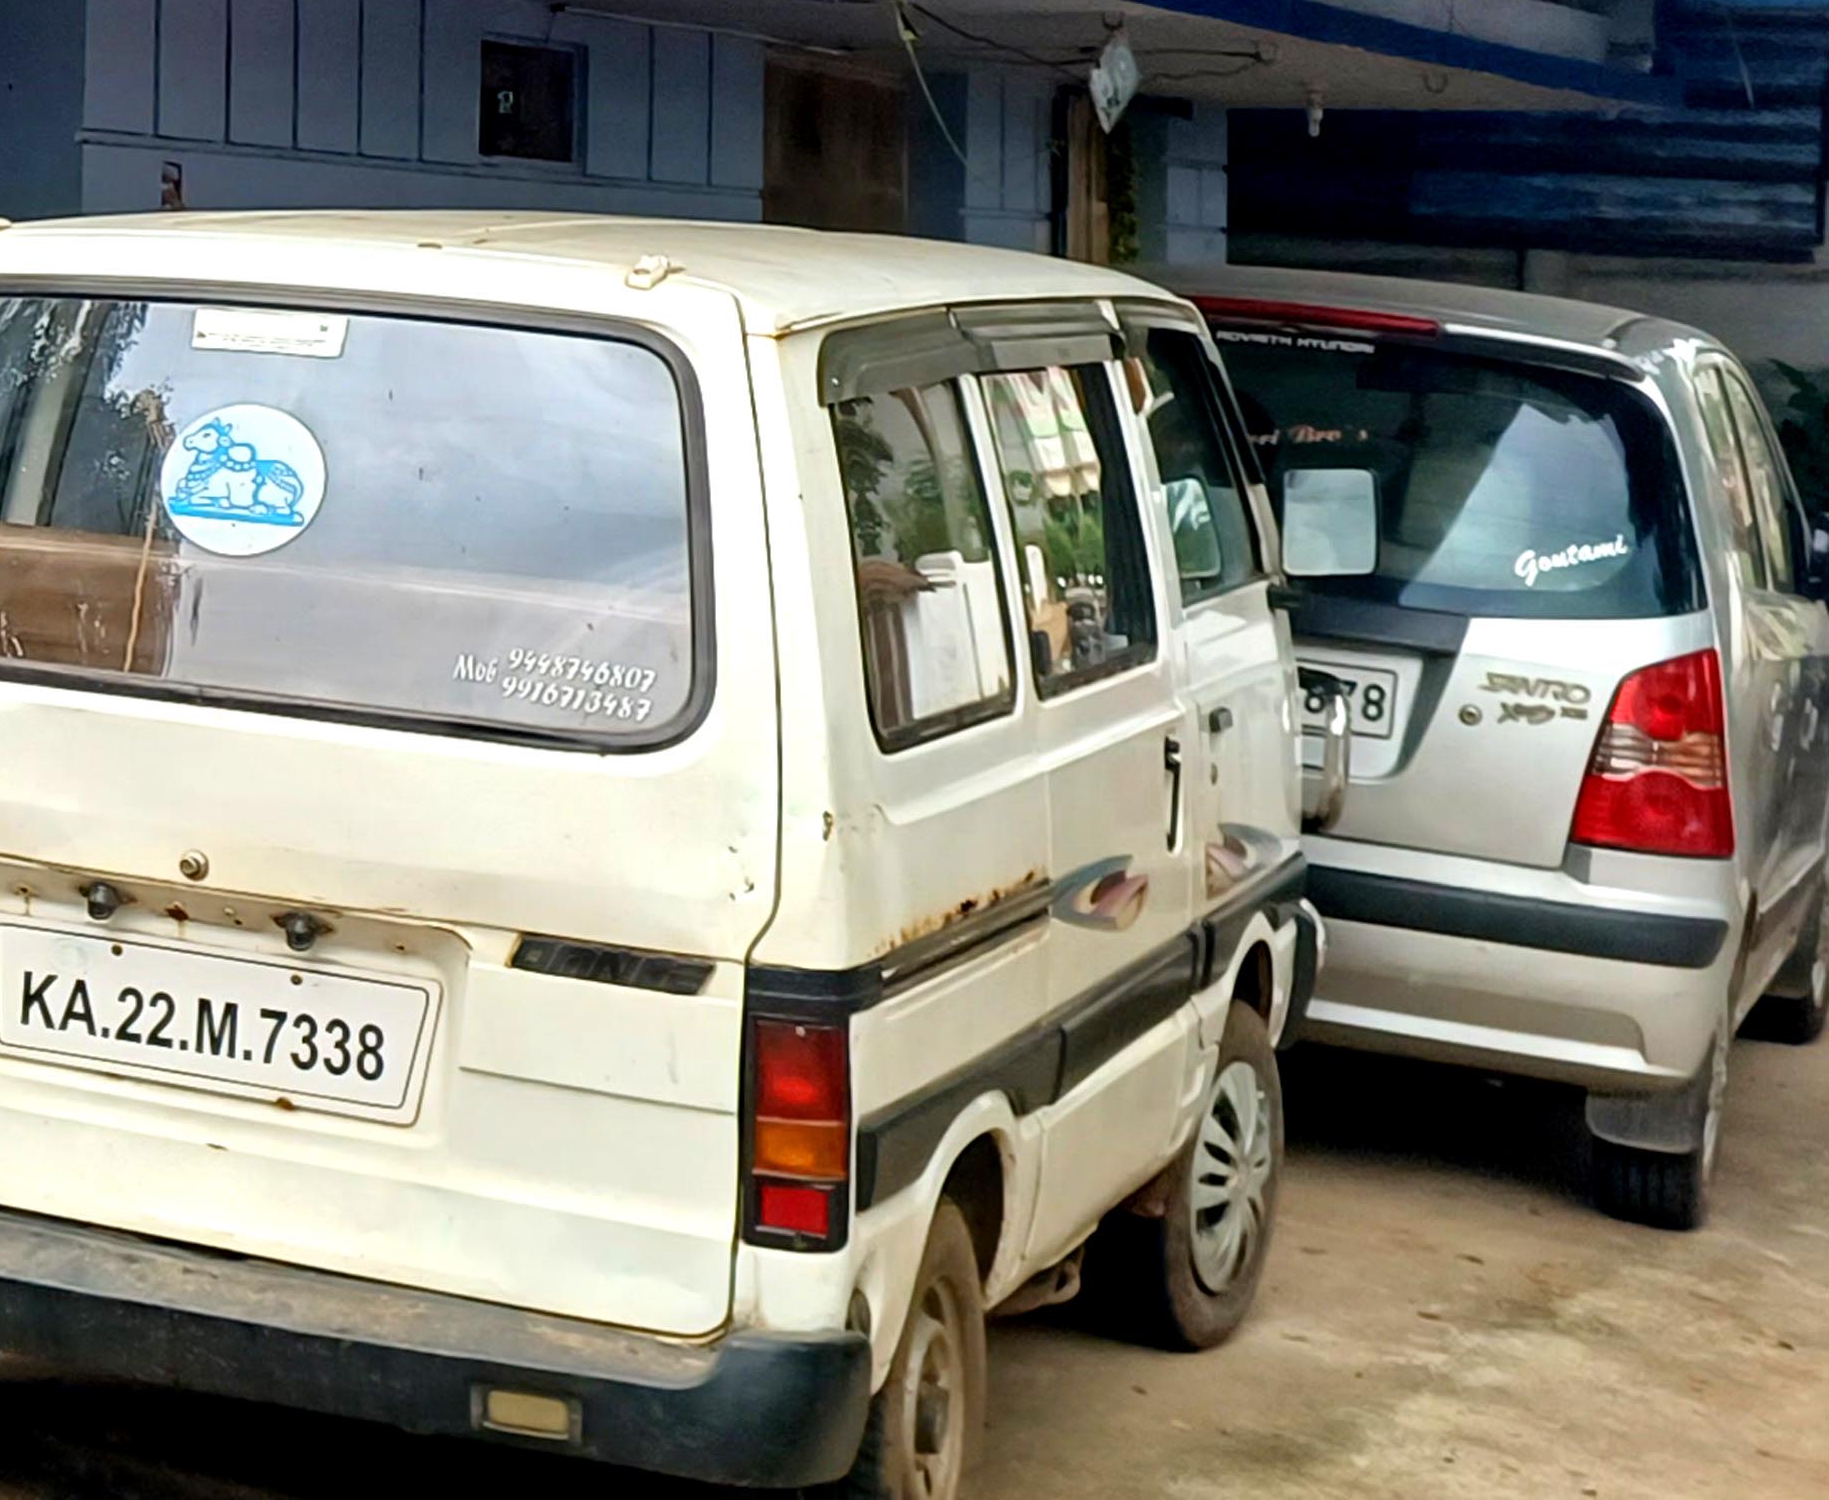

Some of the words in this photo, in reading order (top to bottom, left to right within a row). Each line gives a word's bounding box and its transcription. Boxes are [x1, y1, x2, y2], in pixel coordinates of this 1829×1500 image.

[1514, 533, 1629, 587] Goutami
[509, 647, 656, 693] 9448746807
[502, 676, 652, 722] 9916713487
[20, 970, 386, 1082] KA.22.M.7338
